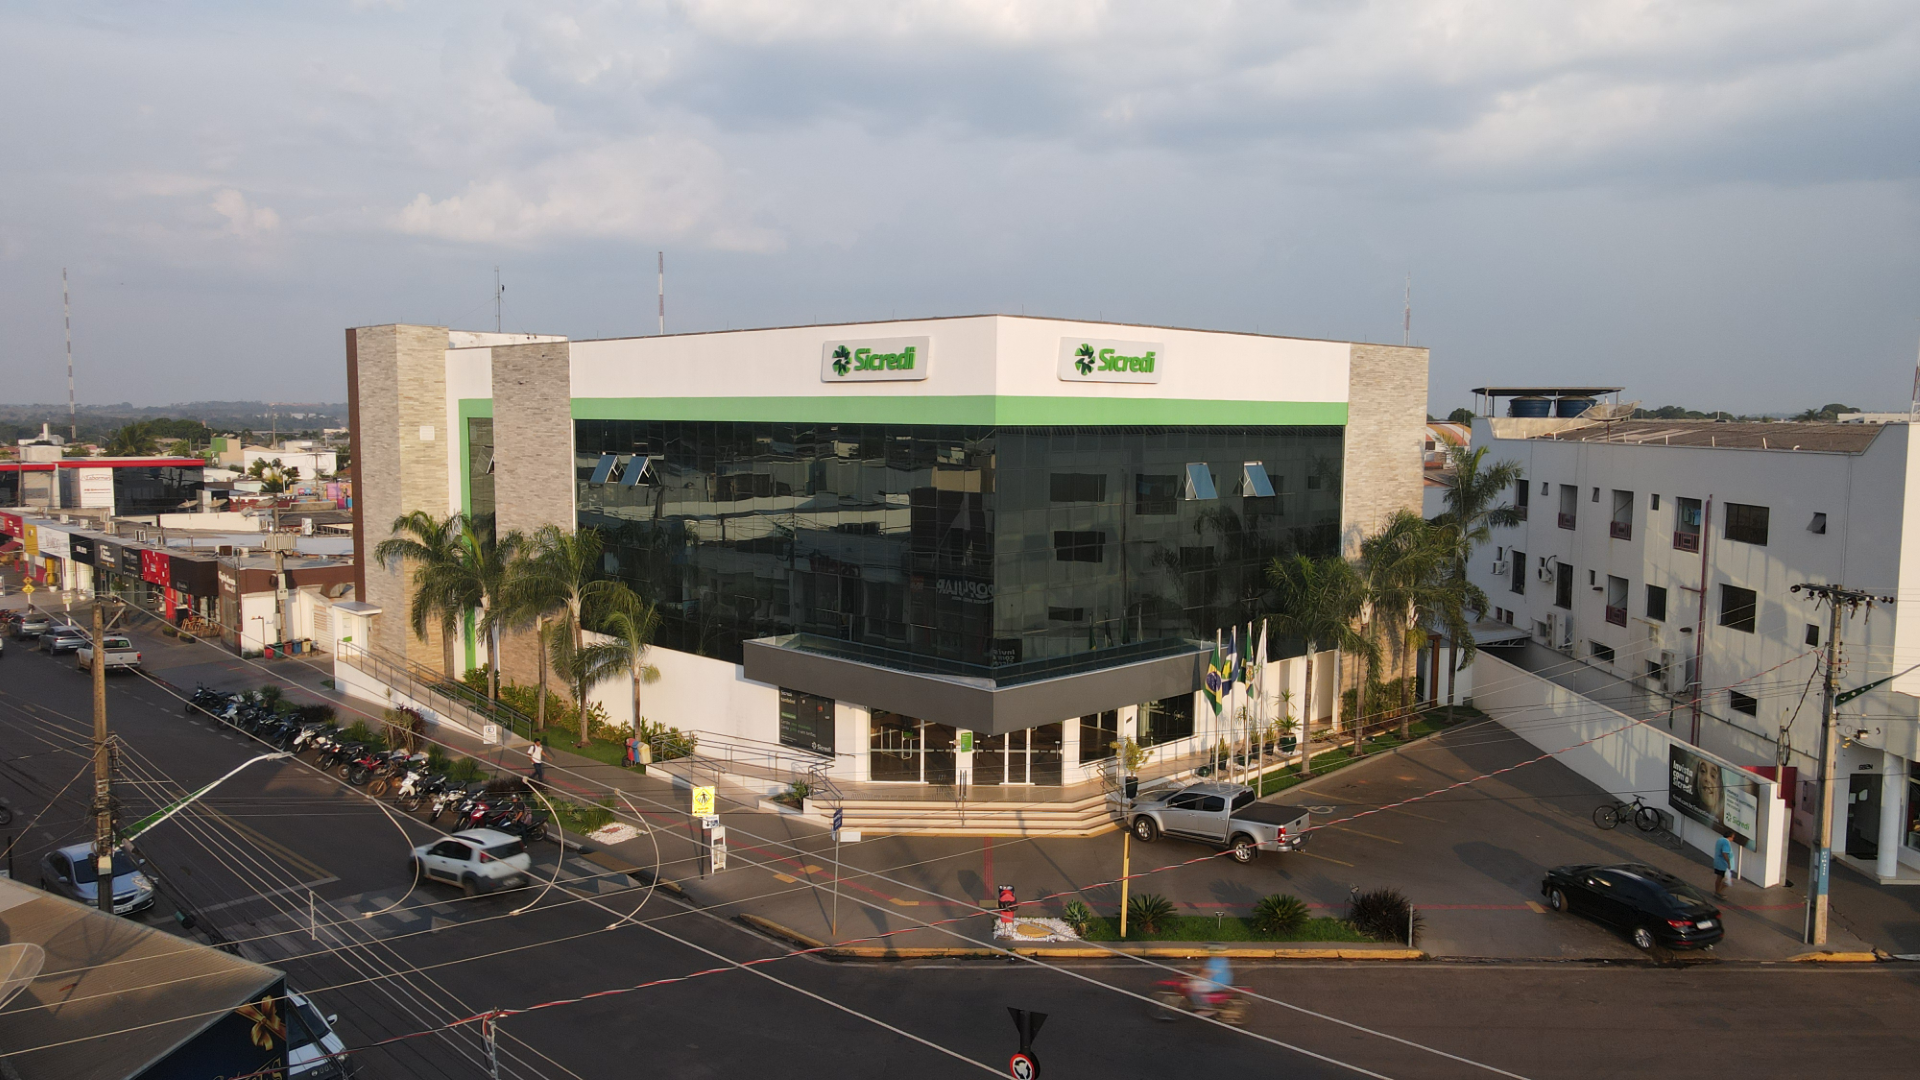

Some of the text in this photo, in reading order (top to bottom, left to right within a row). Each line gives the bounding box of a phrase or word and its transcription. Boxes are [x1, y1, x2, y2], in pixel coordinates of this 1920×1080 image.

[854, 345, 916, 371] Sicredi
[1098, 348, 1156, 373] Sicredi
[1673, 760, 1693, 777] Invista
[1673, 770, 1685, 781] com
[1733, 816, 1750, 830] Sicredi
